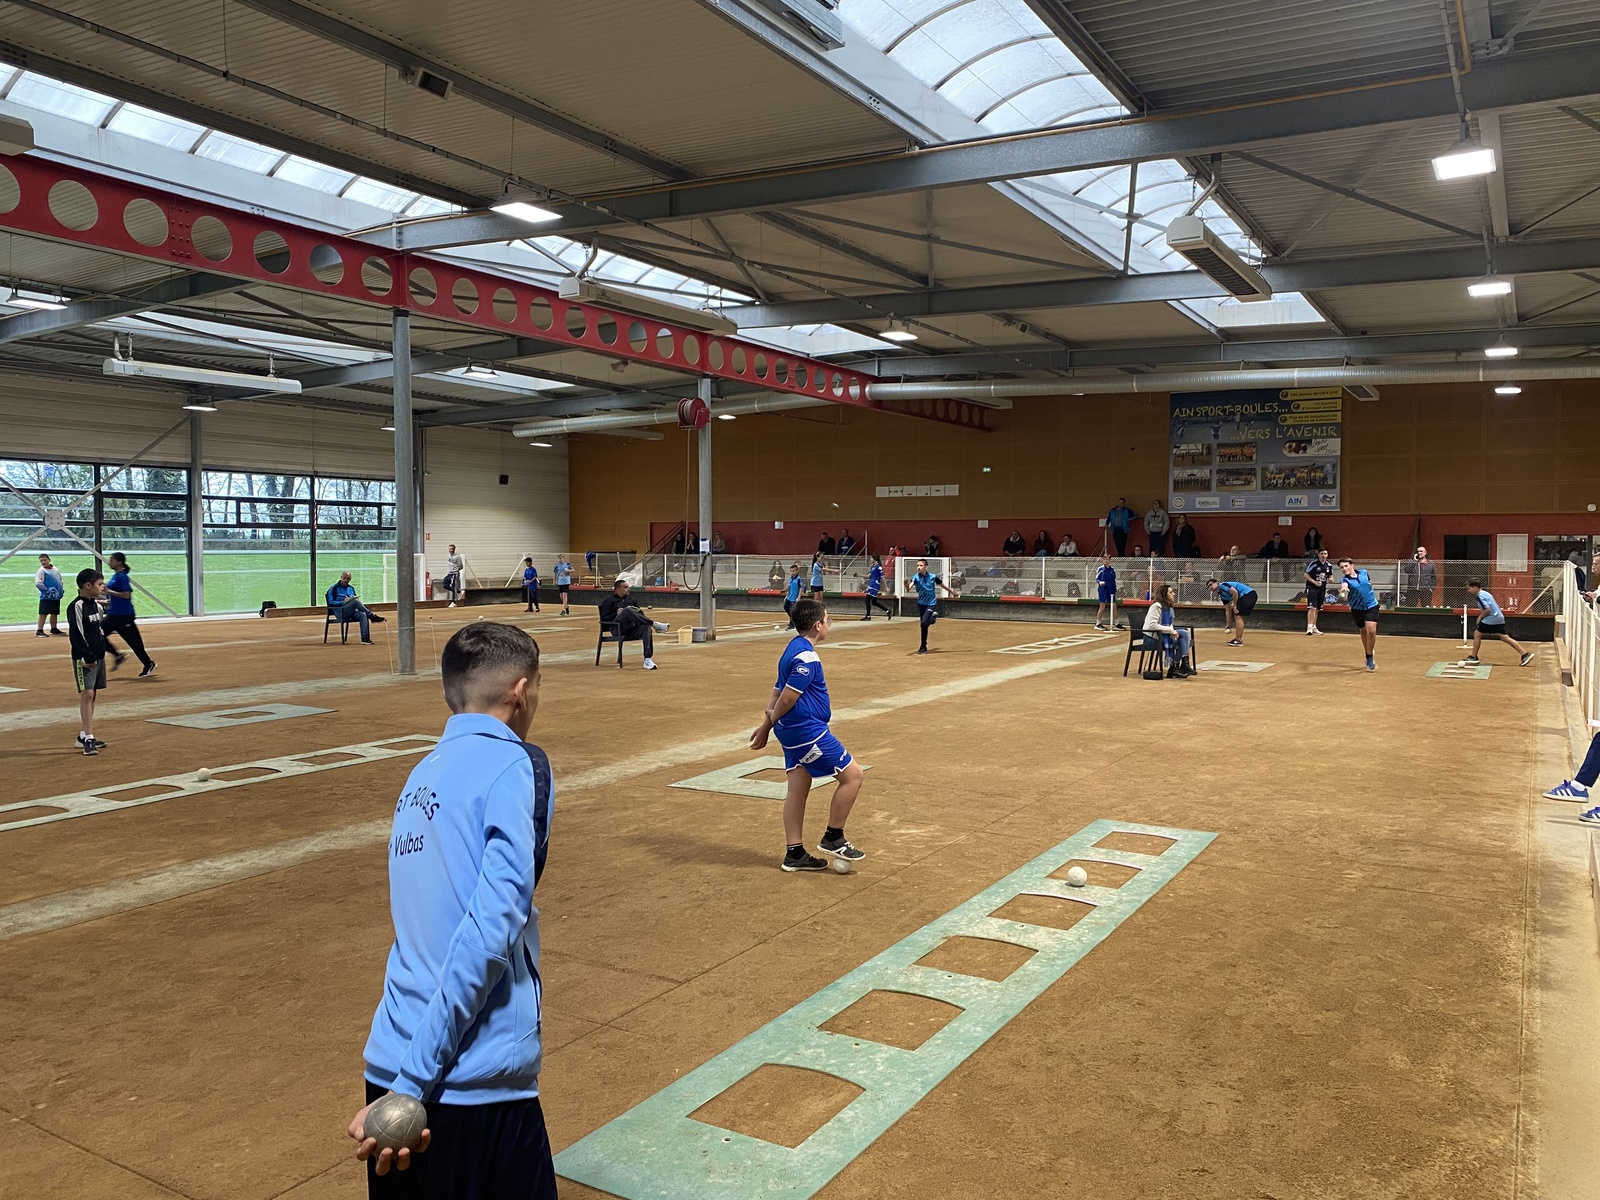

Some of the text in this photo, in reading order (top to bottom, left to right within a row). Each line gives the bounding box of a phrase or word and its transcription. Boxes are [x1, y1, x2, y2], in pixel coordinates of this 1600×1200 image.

[1172, 407, 1194, 418] AIN
[1276, 425, 1338, 438] L'AVENIR
[1287, 497, 1302, 505] AIN
[394, 831, 424, 857] Vulbas
